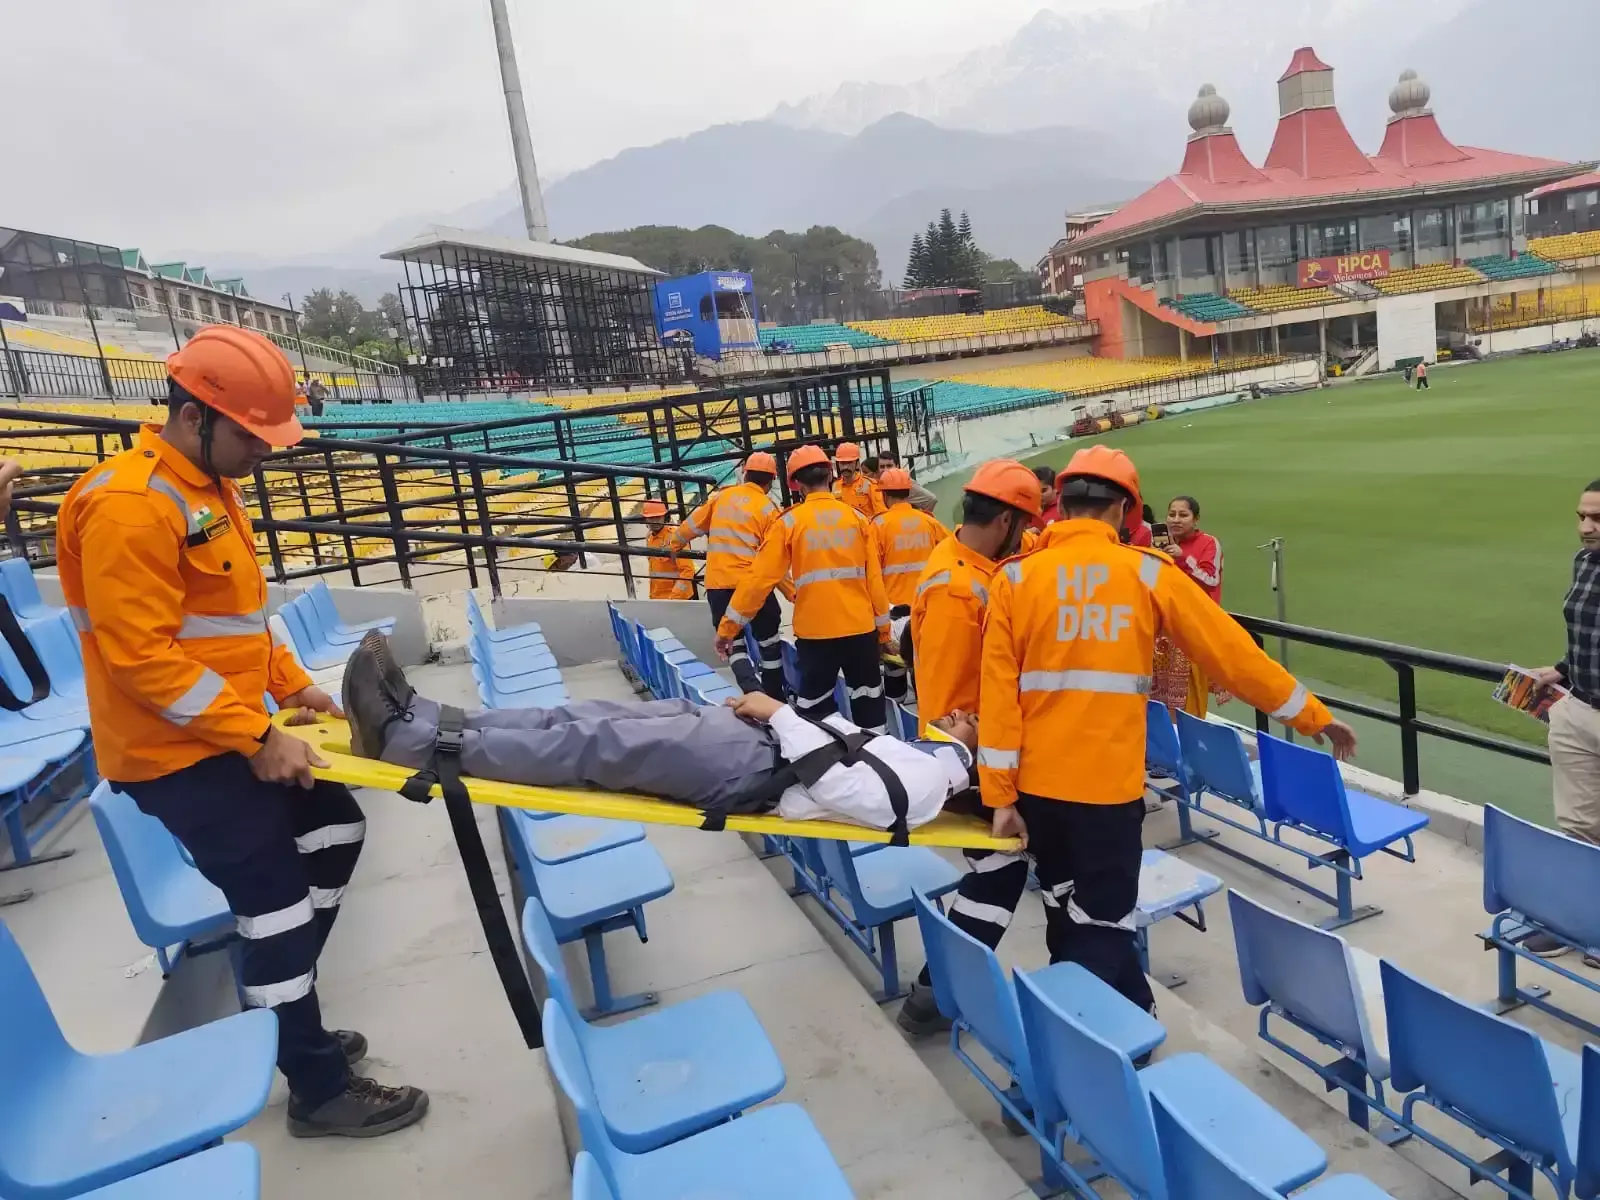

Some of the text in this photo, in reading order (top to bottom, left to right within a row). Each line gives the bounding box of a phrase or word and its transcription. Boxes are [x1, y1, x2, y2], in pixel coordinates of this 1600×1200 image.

[1333, 269, 1388, 282] Welcomes You
[1337, 254, 1382, 273] HPCA
[1057, 565, 1109, 600] HP
[1056, 604, 1133, 642] DRF
